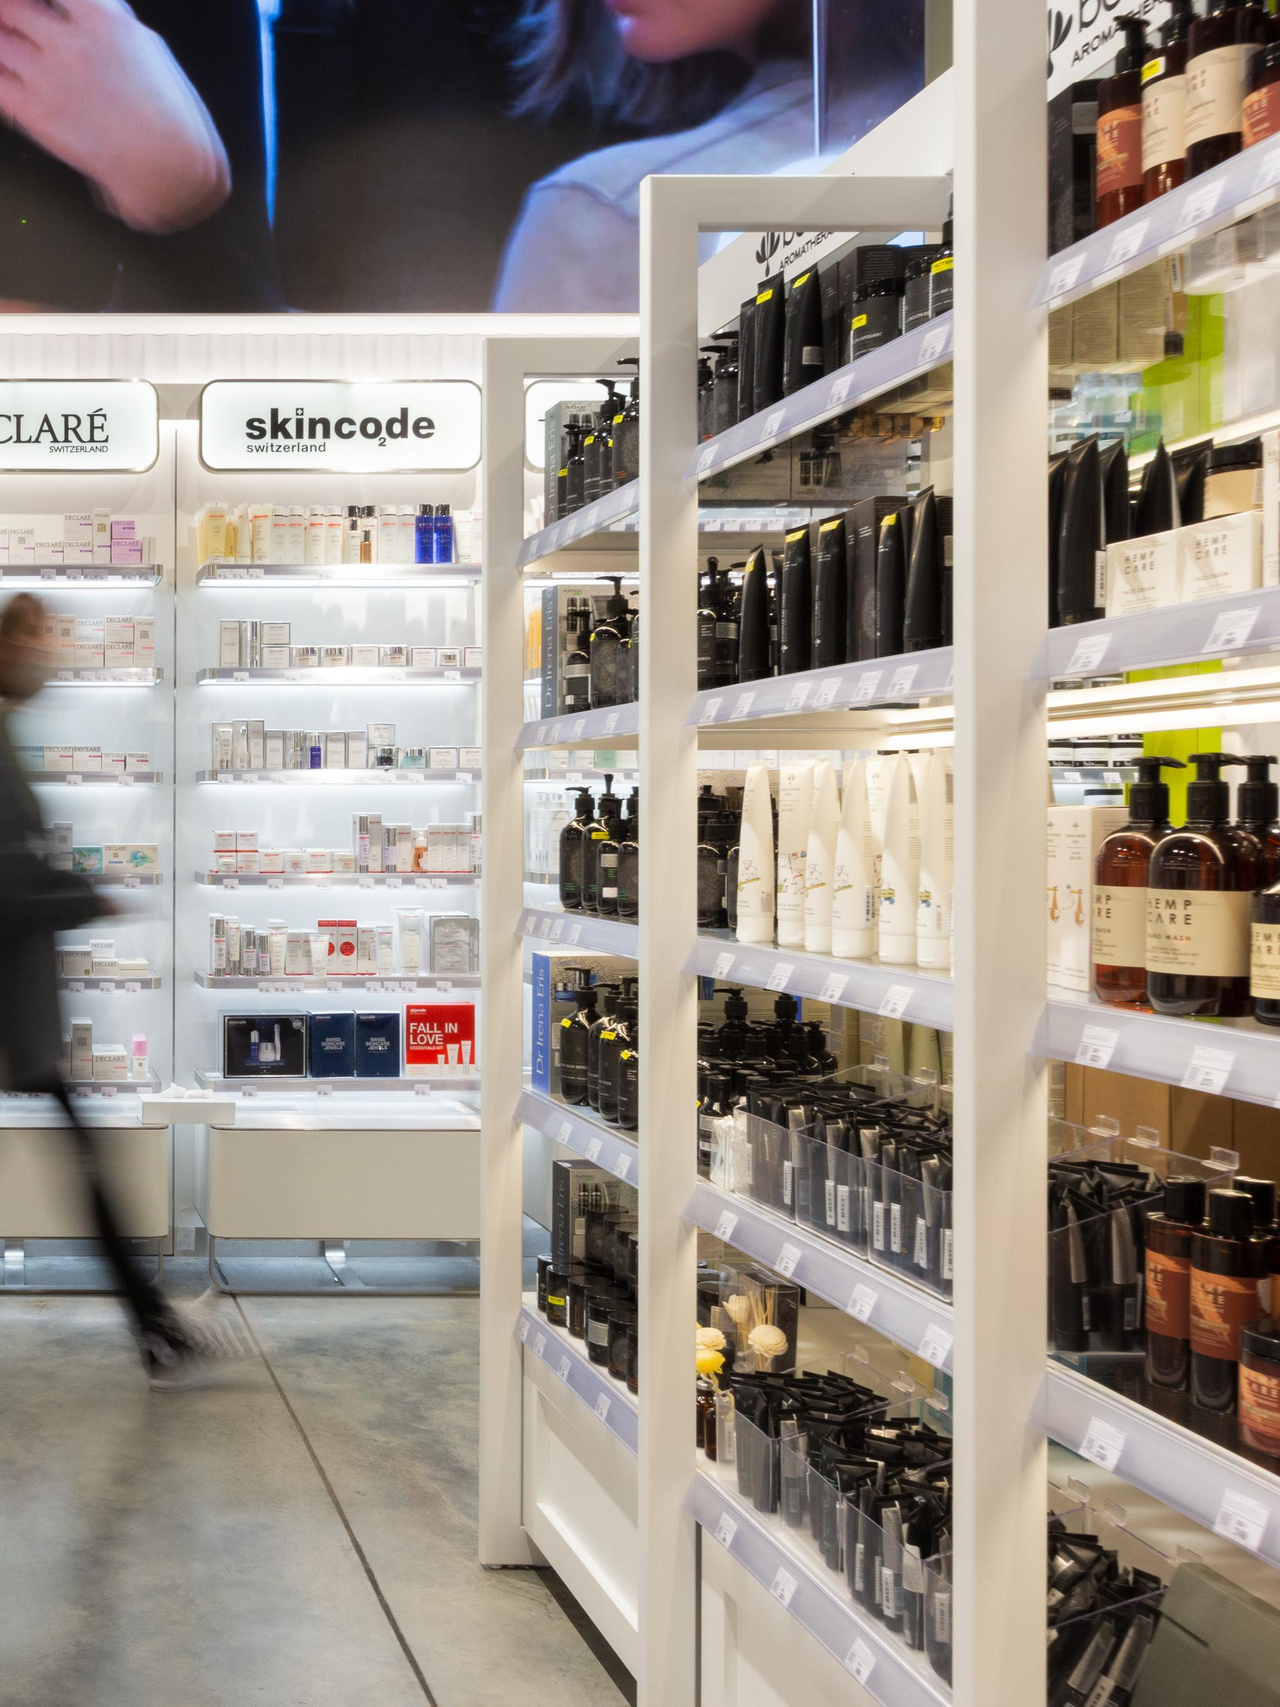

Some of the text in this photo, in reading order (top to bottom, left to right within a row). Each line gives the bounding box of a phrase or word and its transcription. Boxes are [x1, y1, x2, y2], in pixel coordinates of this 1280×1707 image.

[245, 407, 436, 440] skincode
[548, 420, 557, 450] Eris
[246, 442, 326, 453] switzerland
[548, 455, 557, 498] Irena
[1195, 534, 1227, 549] HEMP
[1123, 551, 1155, 564] HEMP
[1195, 546, 1227, 560] CARE
[1124, 561, 1155, 575] CARE
[545, 601, 553, 708] Dr Irena Eris
[1165, 934, 1192, 942] WASH
[410, 1023, 458, 1033] FALL IN
[536, 968, 545, 1075] Dr Irena Eris
[410, 1034, 444, 1045] LOVE
